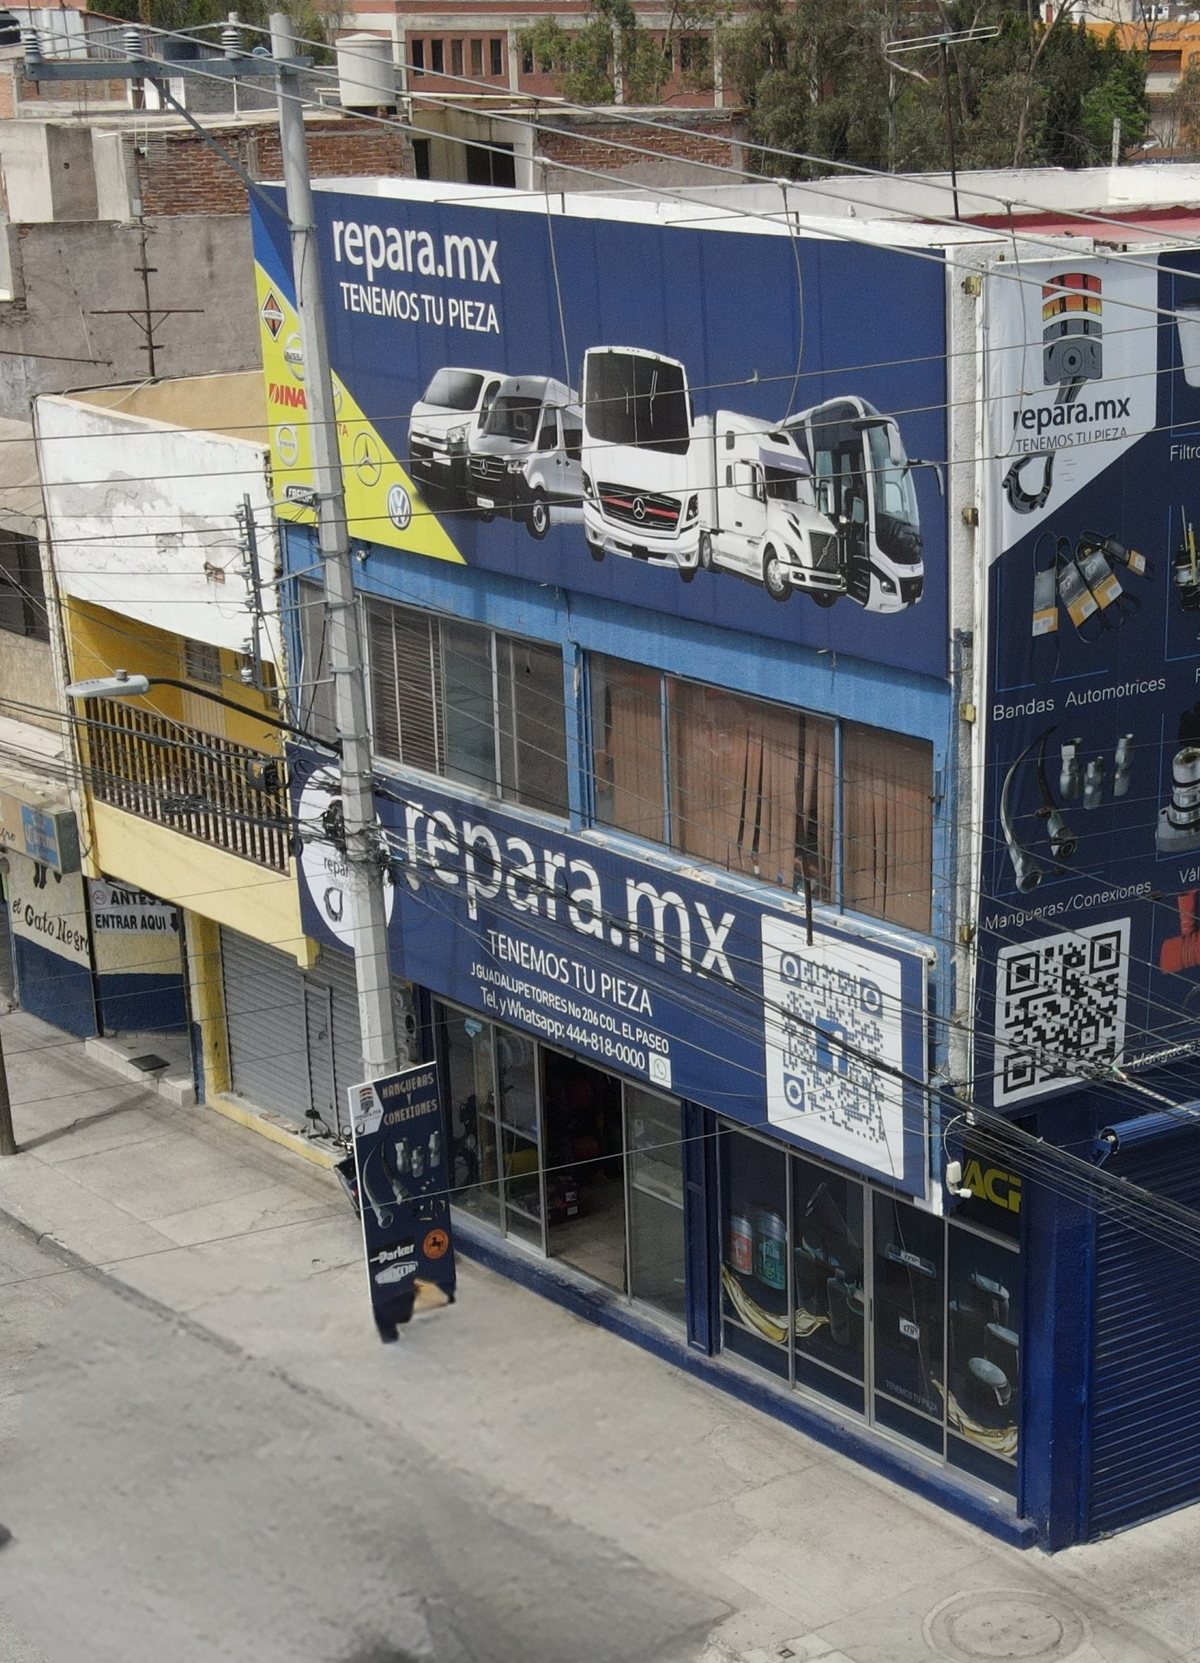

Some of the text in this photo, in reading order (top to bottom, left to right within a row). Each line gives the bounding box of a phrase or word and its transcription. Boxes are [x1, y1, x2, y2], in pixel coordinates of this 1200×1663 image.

[332, 220, 501, 285] repara.mx
[339, 281, 500, 334] TENEMOS TU PIEZA
[268, 383, 307, 410] DINA
[1012, 397, 1132, 436] repara.mx
[1015, 426, 1128, 453] TENEMOS TU PIEZA
[993, 677, 1167, 721] Bandas Automotrices
[405, 799, 739, 987] repara.mx
[984, 880, 1153, 932] Mangueras/Conexiones
[24, 904, 55, 937] Gato
[95, 914, 167, 931] ENTRAR AQUI
[487, 929, 653, 1018] TENEMOS TU PIEZA
[480, 986, 645, 1070] Tel. y Whatsapp: 444-818-0000
[568, 1001, 581, 1019] No
[582, 1006, 599, 1026] 206
[622, 1022, 636, 1041] EL
[636, 1027, 669, 1054] PASEO
[374, 1244, 415, 1264] Parker
